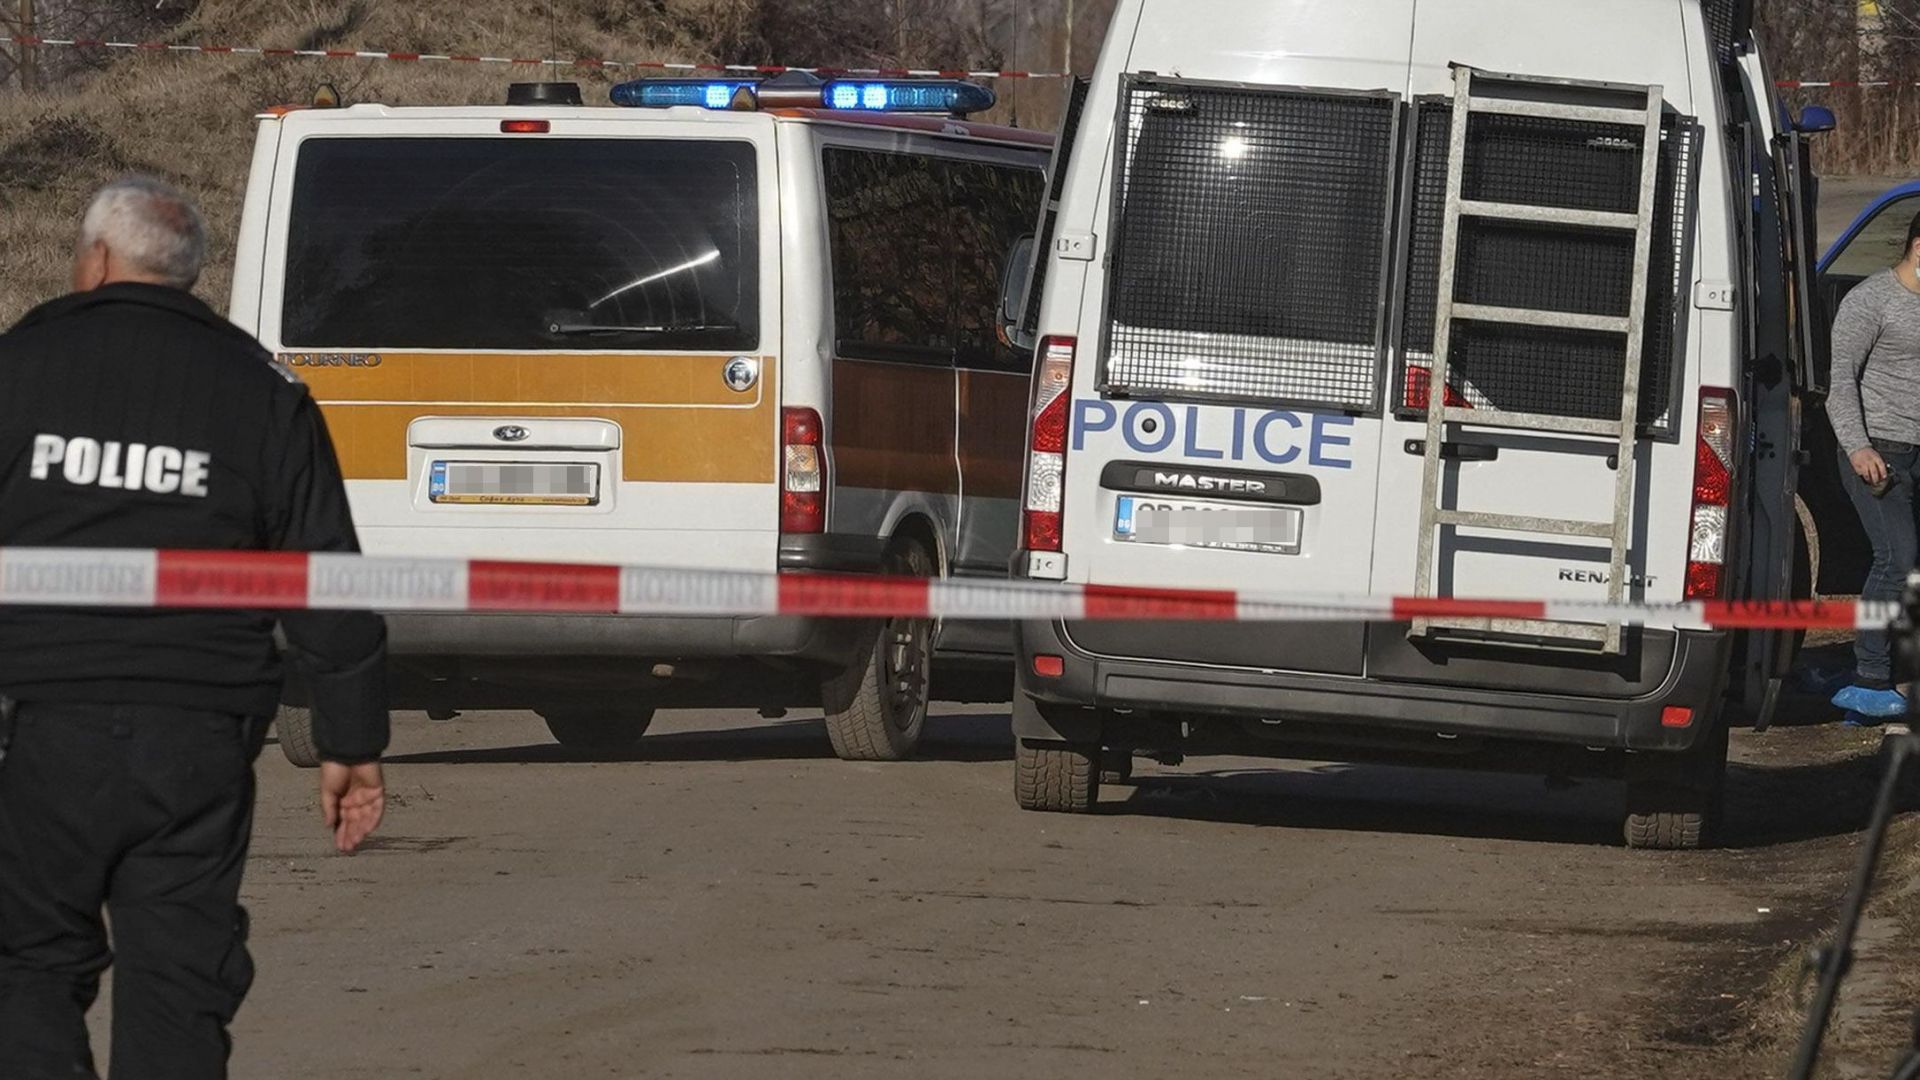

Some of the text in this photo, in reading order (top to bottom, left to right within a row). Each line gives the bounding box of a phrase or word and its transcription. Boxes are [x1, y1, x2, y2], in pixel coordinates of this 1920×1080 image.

[278, 352, 383, 368] TOURNEO
[1071, 398, 1355, 470] POLICE
[30, 433, 211, 498] POLICE
[1154, 471, 1266, 495] MASTER
